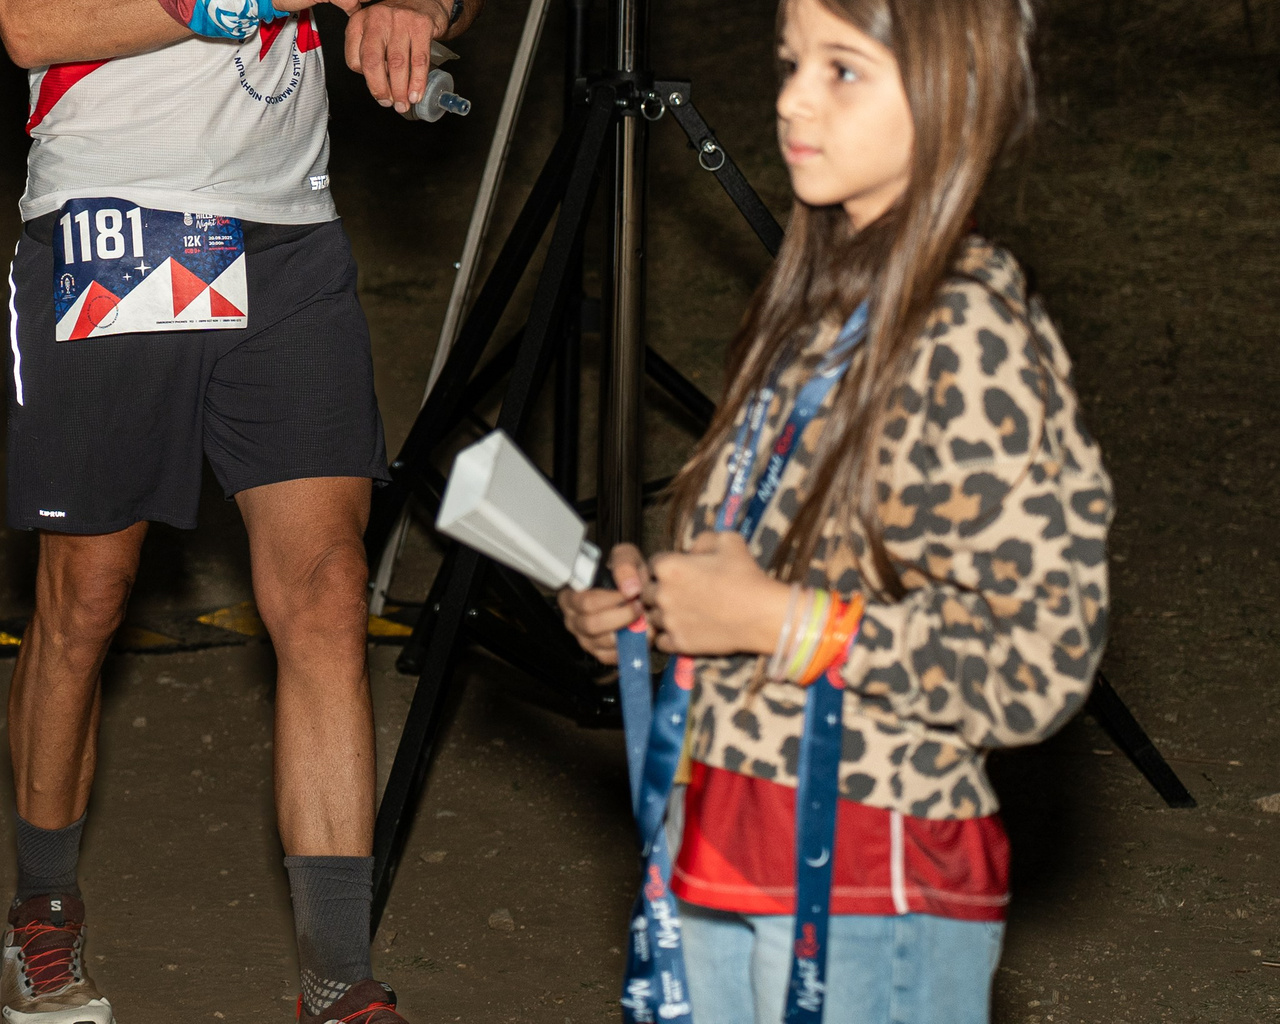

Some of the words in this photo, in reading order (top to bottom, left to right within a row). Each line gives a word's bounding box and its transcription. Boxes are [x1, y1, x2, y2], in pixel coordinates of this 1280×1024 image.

[234, 56, 246, 78] RUN
[292, 54, 302, 77] HILLS
[240, 78, 263, 102] NIGHT
[289, 77, 299, 88] IN
[59, 206, 144, 265] 1181
[195, 218, 217, 232] Night
[183, 235, 202, 247] 12K
